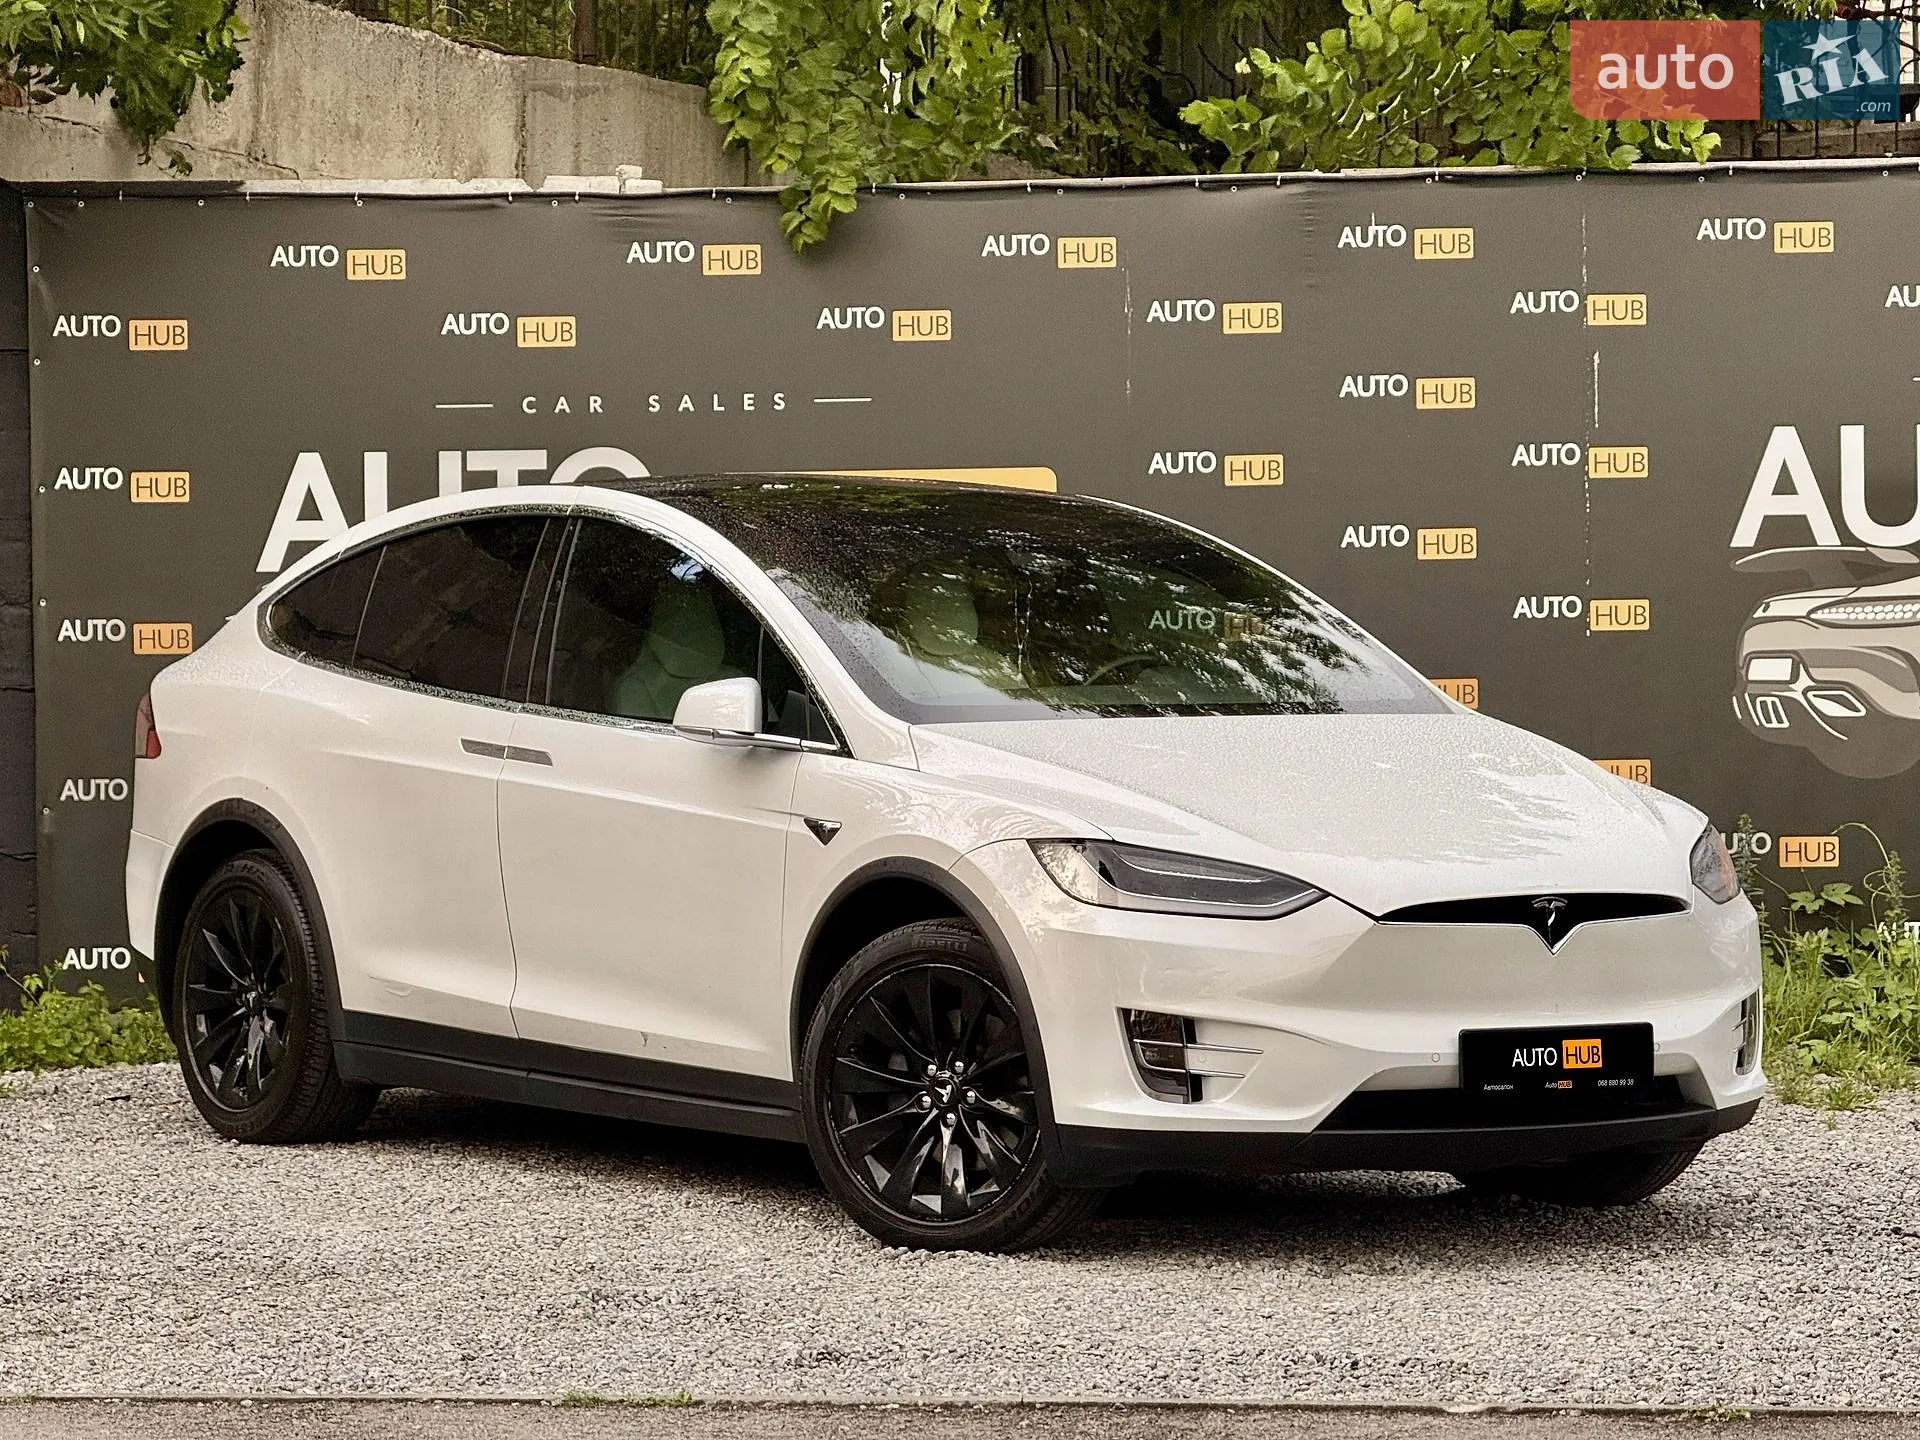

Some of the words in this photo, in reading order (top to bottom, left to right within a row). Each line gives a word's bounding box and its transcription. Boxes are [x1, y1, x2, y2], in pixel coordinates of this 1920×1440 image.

[981, 233, 1051, 258] AUTO
[1064, 242, 1113, 263] HUB
[1337, 225, 1407, 249] AUTO
[1420, 233, 1471, 255] HUB
[1695, 217, 1767, 241] AUTO
[1779, 227, 1828, 248] HUB
[270, 244, 340, 268] AUTO
[352, 254, 403, 276] HUB
[626, 240, 695, 264] AUTO
[708, 249, 759, 272] HUB
[1509, 289, 1580, 315] AUTO
[1592, 299, 1643, 322] HUB
[1884, 285, 1920, 308] AU
[440, 312, 510, 336] AUTO
[522, 321, 573, 344] HUB
[816, 306, 885, 330] AUTO
[898, 315, 948, 337] HUB
[1146, 298, 1216, 323] AUTO
[1228, 307, 1279, 329] HUB
[52, 314, 122, 338] AUTO
[134, 324, 186, 348] HUB
[523, 396, 602, 415] CAR
[648, 393, 786, 413] SALES
[1338, 373, 1409, 398] AUTO
[1421, 382, 1472, 405] HUB
[1147, 450, 1217, 475] AUTO
[1230, 459, 1281, 483] HUB
[1511, 442, 1581, 467] AUTO
[1594, 452, 1645, 474] HUB
[53, 467, 124, 490] AUTO
[135, 476, 188, 498] HUB
[1340, 524, 1410, 549] AUTO
[1423, 533, 1474, 556] HUB
[1149, 609, 1215, 630] AUTO
[1512, 595, 1583, 619] AUTO
[1595, 604, 1648, 627] HUB
[57, 618, 126, 642] AUTO
[138, 628, 192, 651] HUB
[59, 778, 128, 801] AUTO
[1784, 841, 1839, 864] HUB
[62, 947, 131, 970] AUTO
[1511, 1047, 1558, 1068] AUTO
[1565, 1045, 1600, 1065] HUB
[1544, 1081, 1557, 1089] Auto
